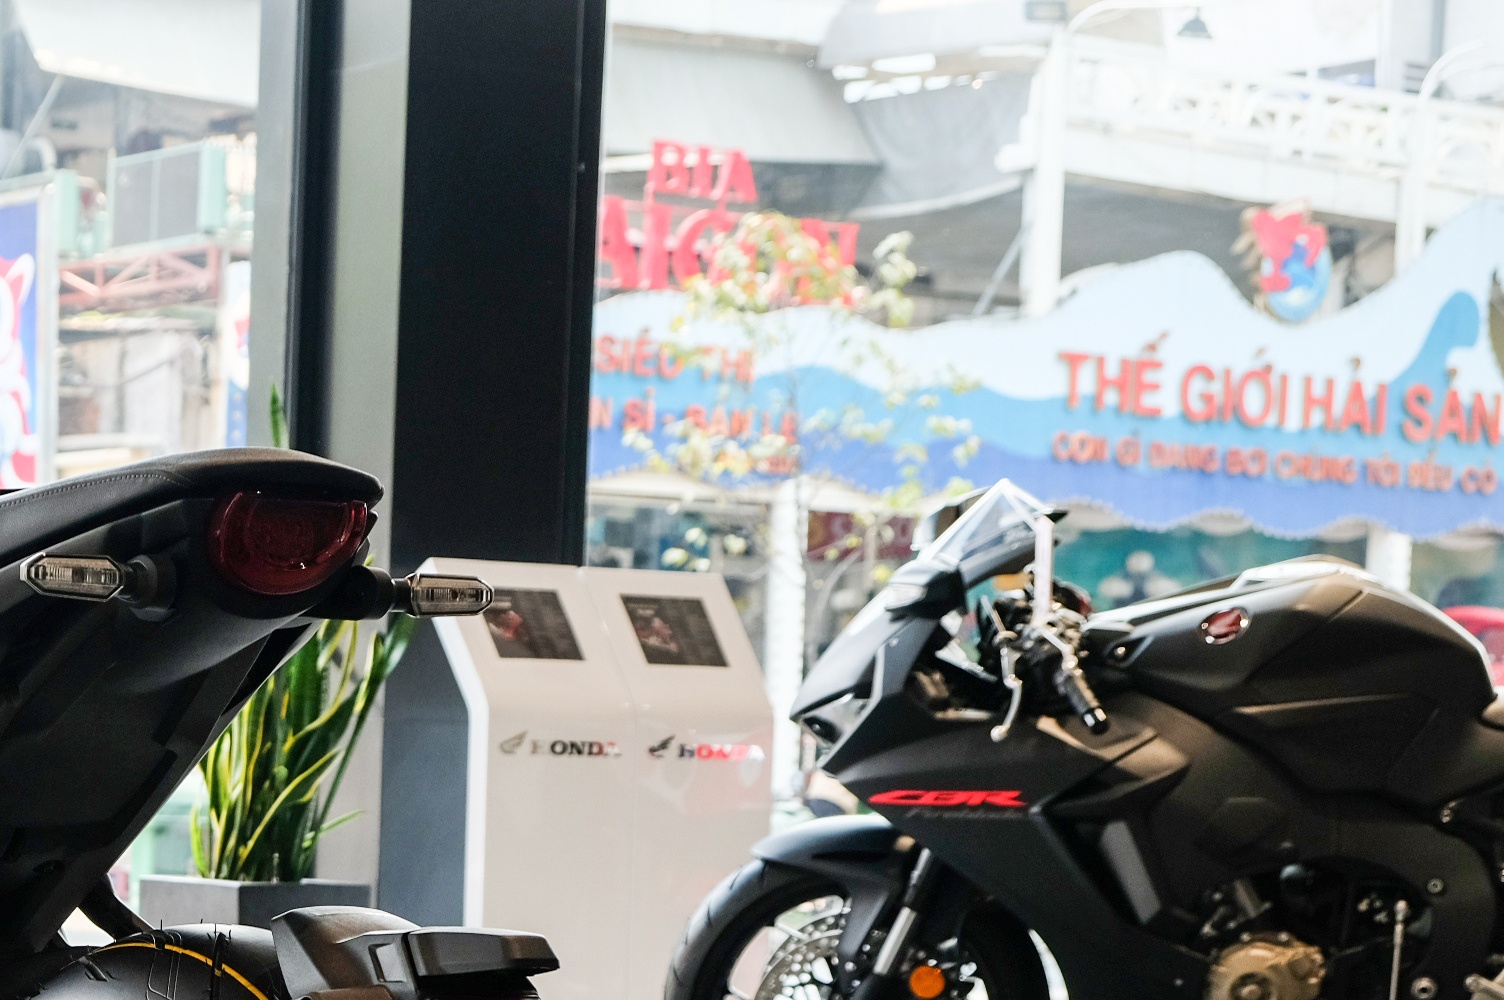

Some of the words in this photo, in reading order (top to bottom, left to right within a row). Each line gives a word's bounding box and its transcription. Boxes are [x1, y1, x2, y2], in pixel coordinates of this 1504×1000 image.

[1058, 331, 1168, 418] THẾ
[1180, 347, 1289, 430] GIỚI
[1302, 357, 1388, 436] HẢI
[1402, 367, 1502, 446] SẢN
[868, 789, 1028, 807] CBR
